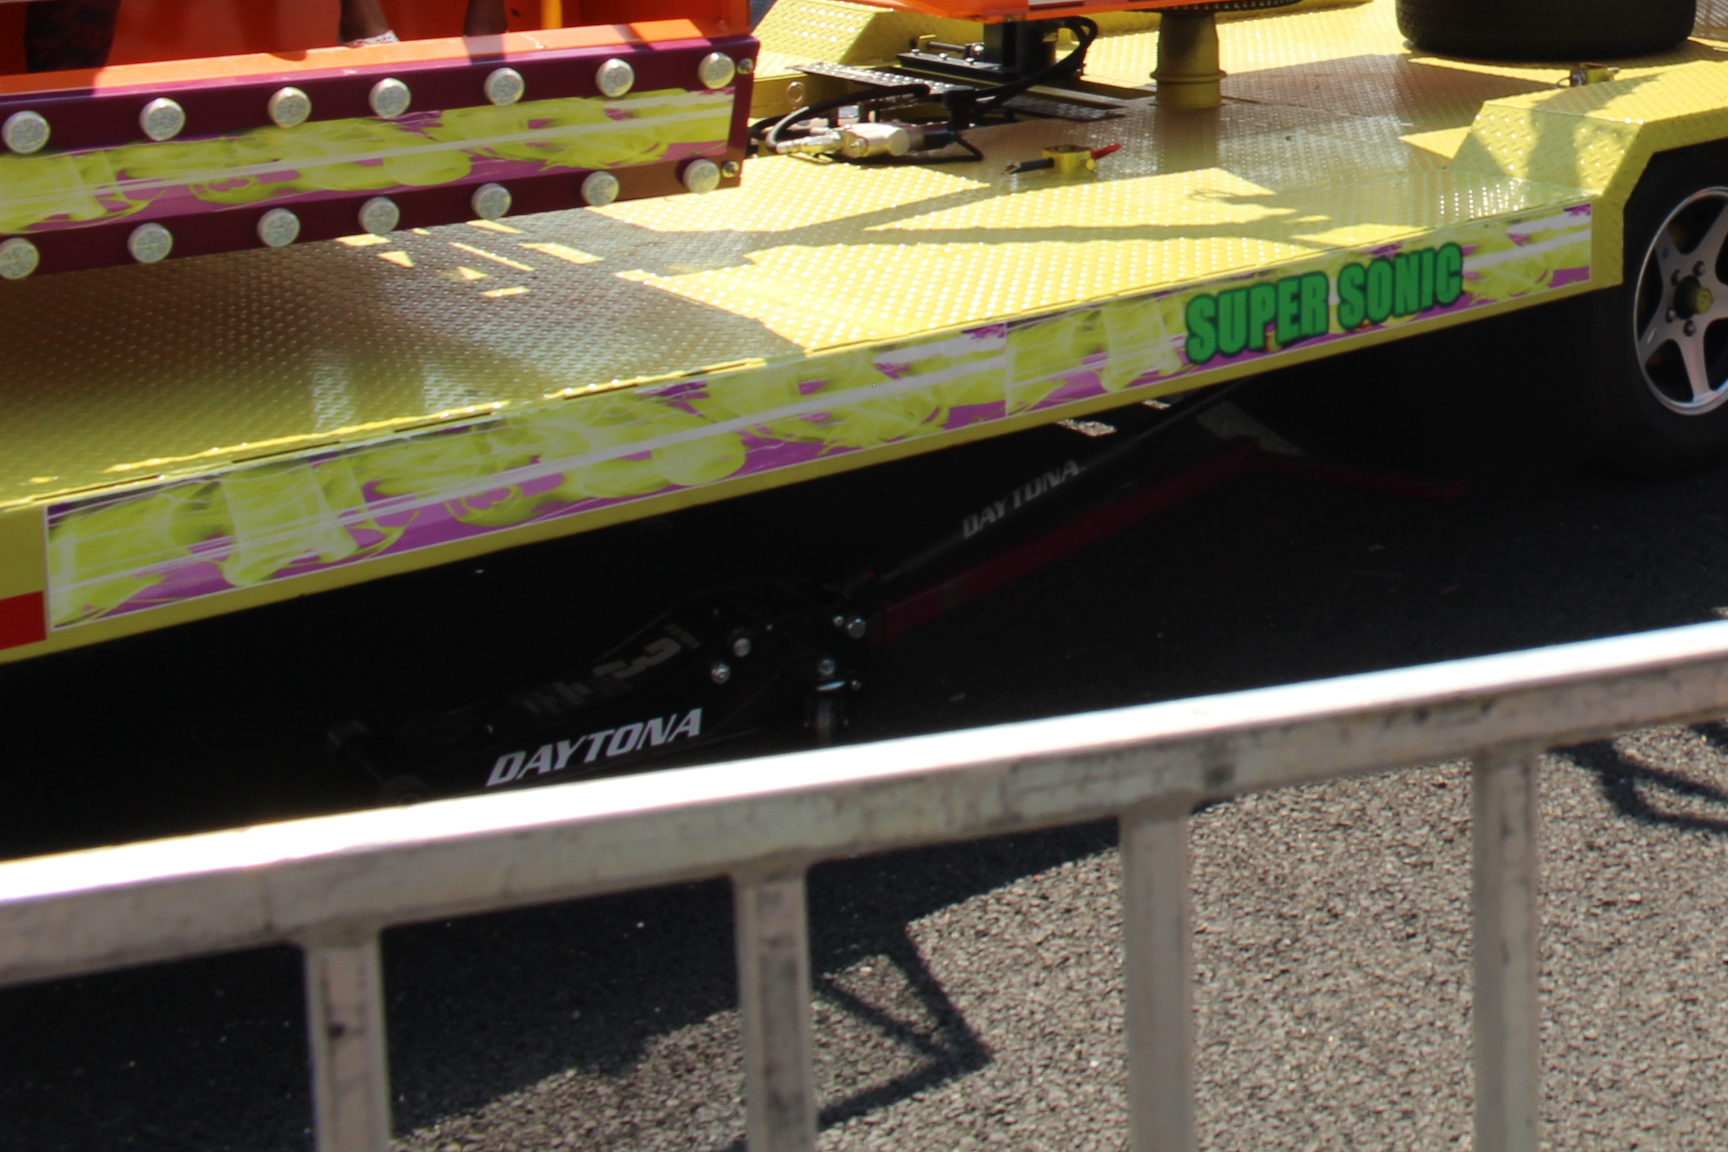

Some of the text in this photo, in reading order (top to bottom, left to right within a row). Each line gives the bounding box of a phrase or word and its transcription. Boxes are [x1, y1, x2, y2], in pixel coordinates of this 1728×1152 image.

[1185, 243, 1463, 364] SUPER SONIC
[962, 459, 1082, 538] DAYTONA
[486, 708, 702, 787] DAYTONA
